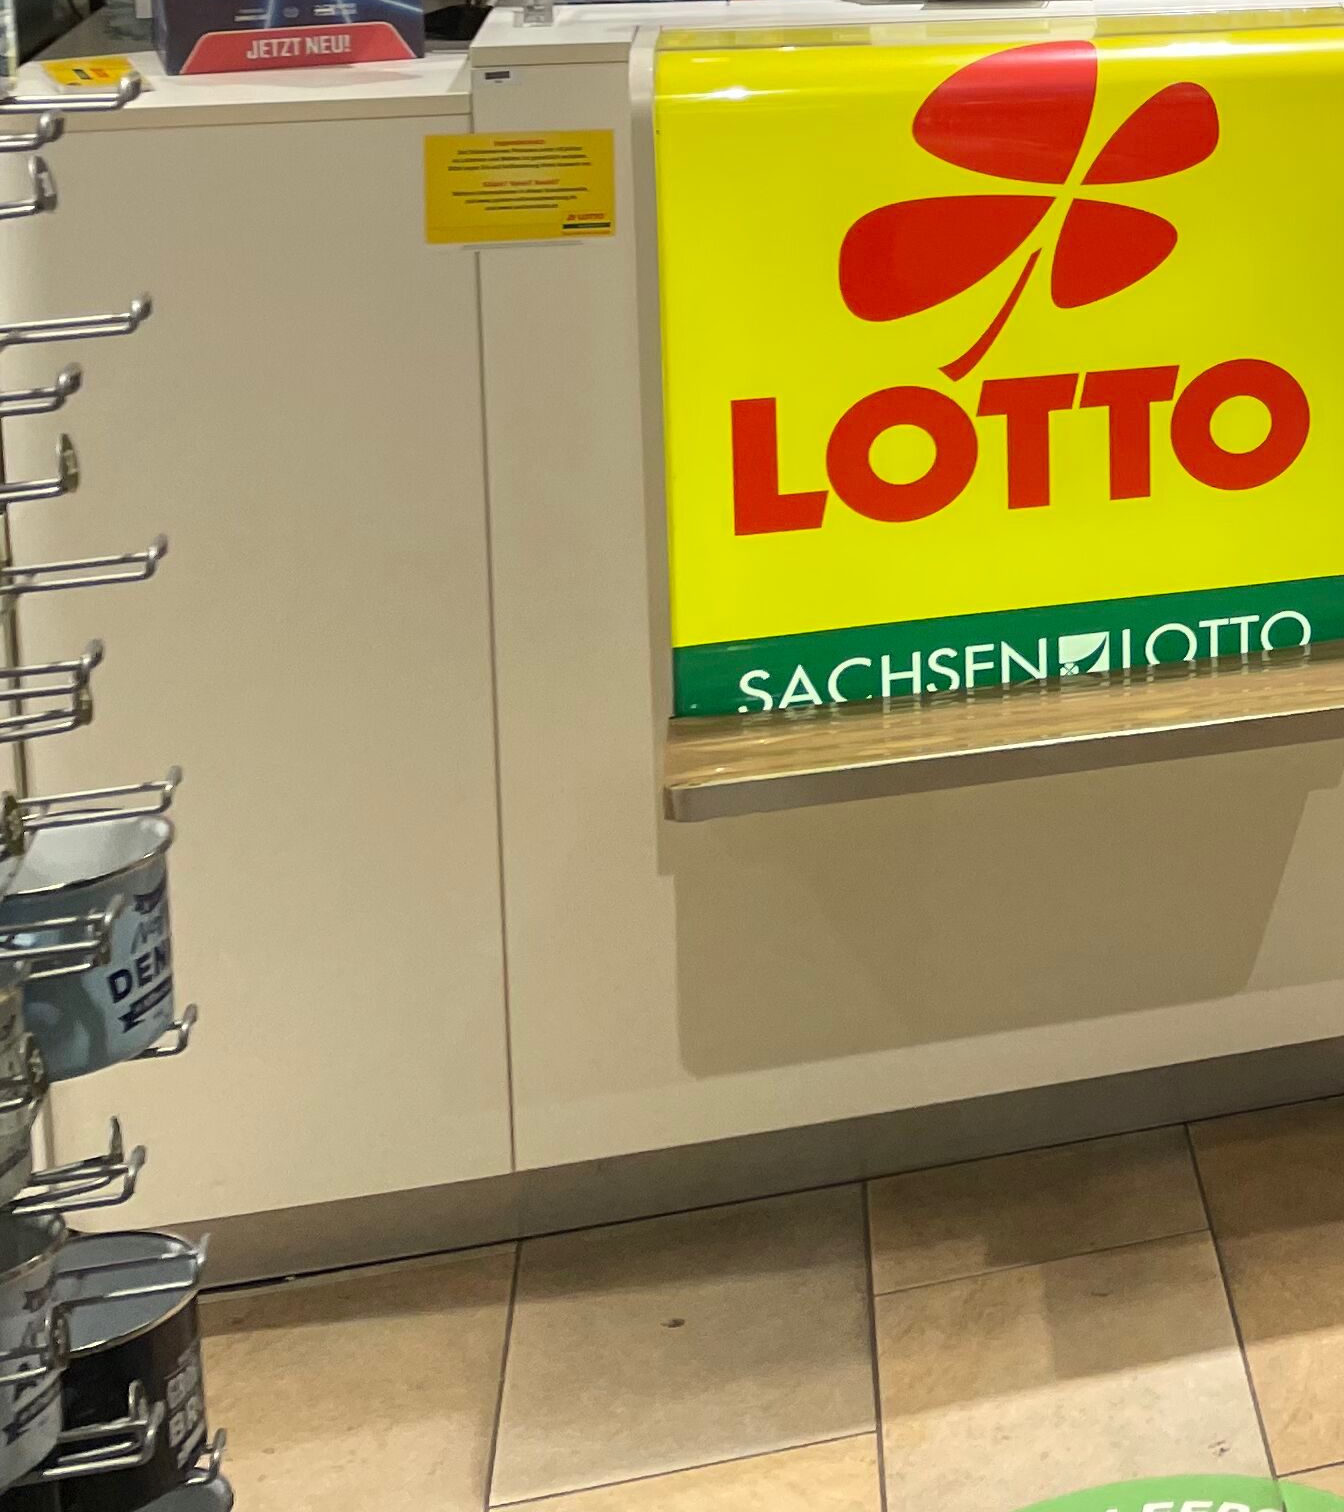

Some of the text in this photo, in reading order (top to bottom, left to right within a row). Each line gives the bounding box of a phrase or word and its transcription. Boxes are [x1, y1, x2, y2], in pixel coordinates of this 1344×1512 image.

[247, 35, 352, 59] JETZT NEU!
[731, 357, 1311, 536] LOTTO
[737, 637, 1047, 717] SACHSEN
